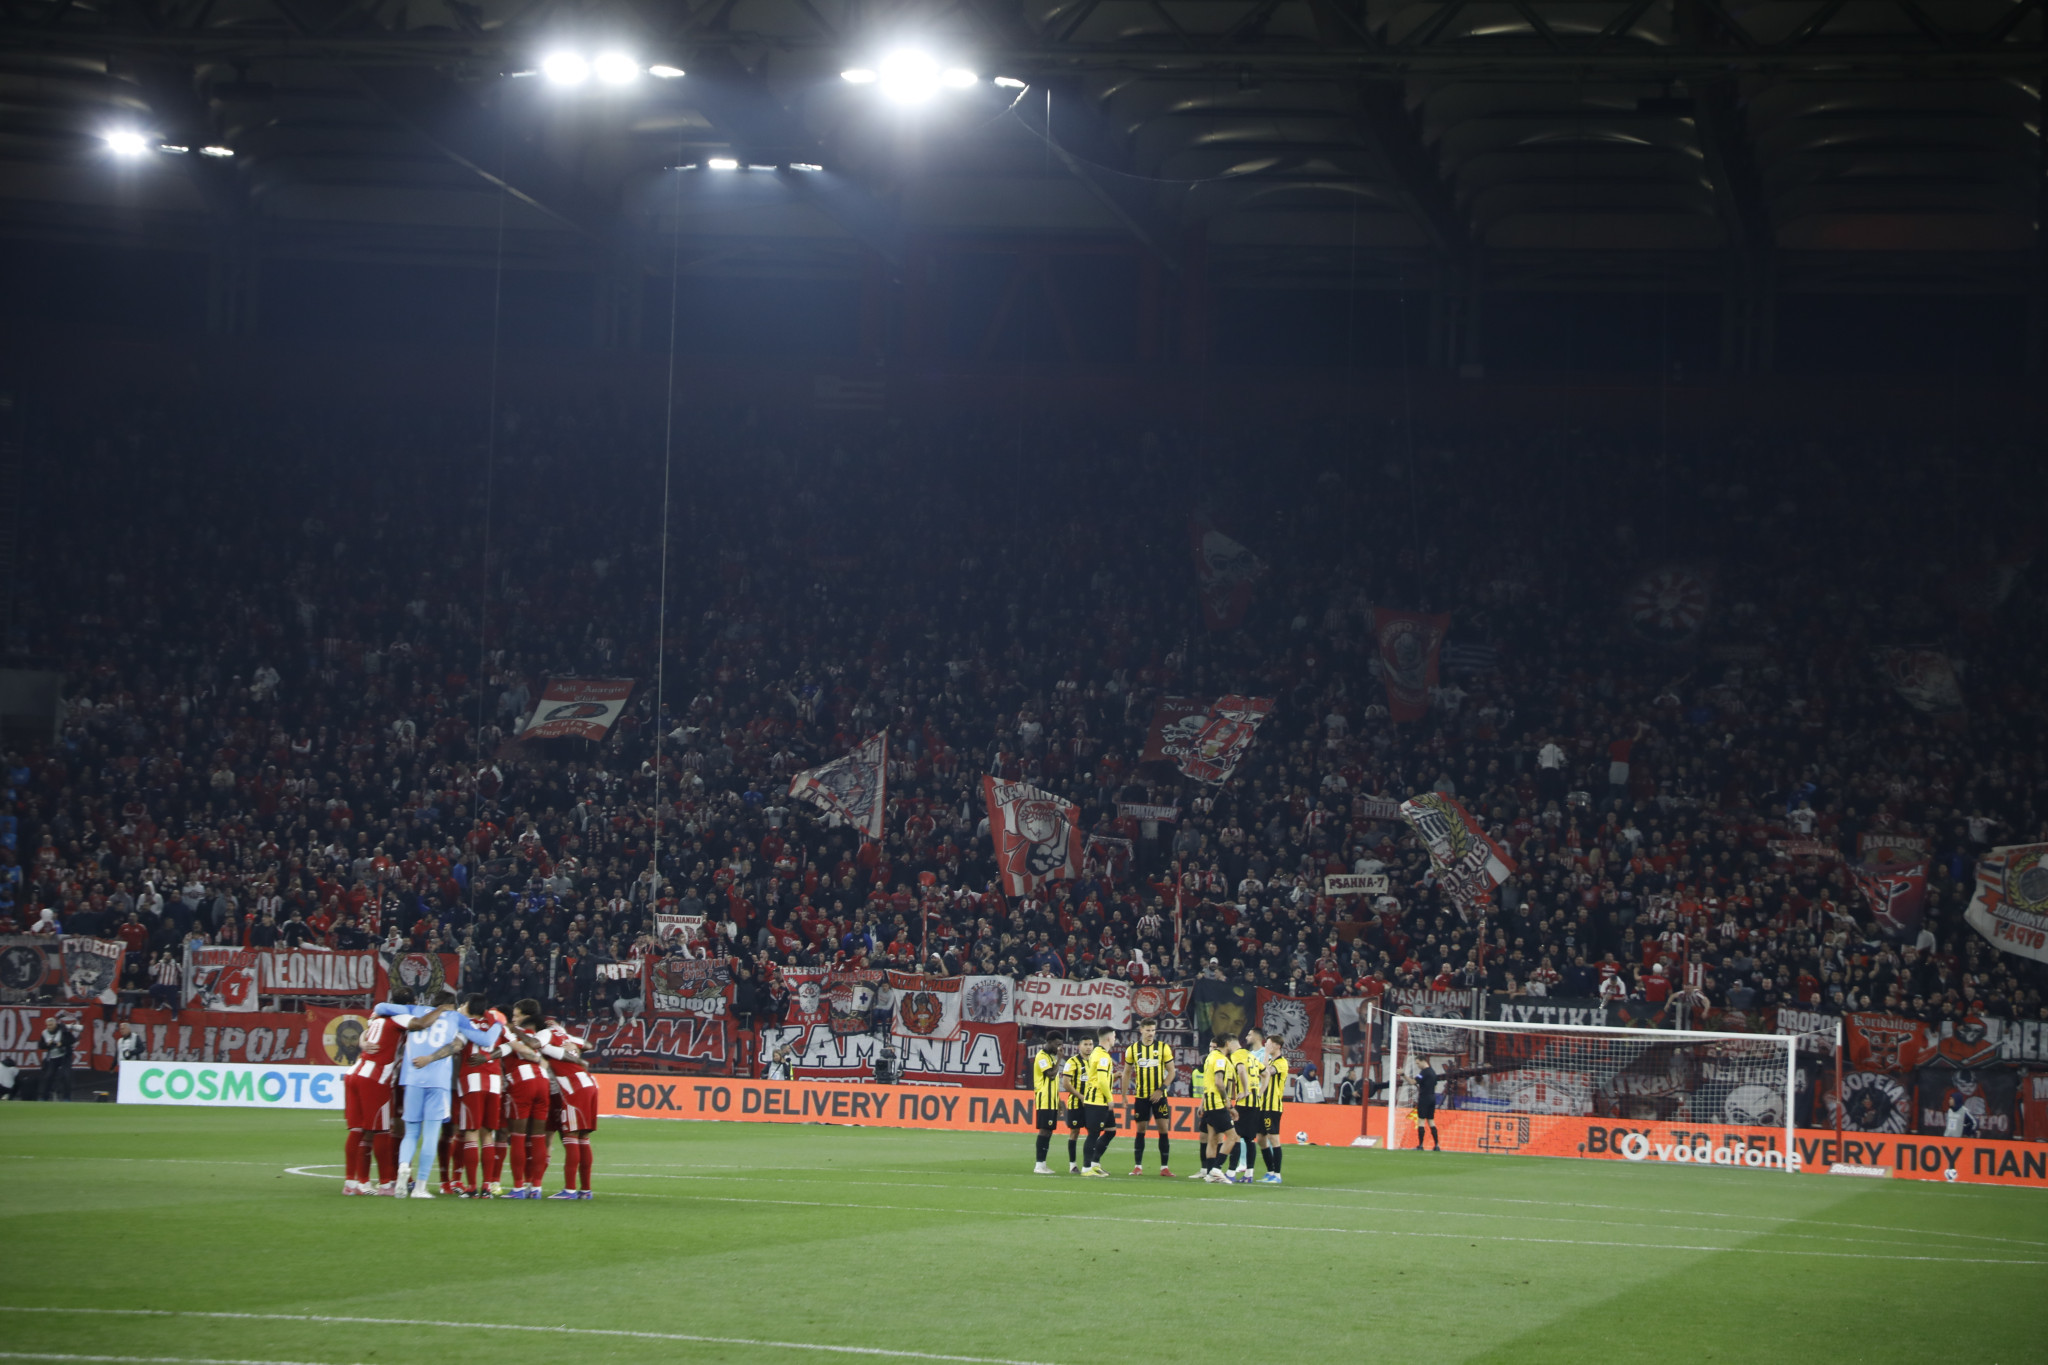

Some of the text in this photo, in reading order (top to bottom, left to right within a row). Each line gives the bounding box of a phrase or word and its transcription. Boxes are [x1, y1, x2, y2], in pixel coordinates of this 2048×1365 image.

[992, 782, 1073, 809] KAMINIA
[1364, 801, 1401, 818] ΕΡΕΤΡΙ
[1863, 836, 1927, 852] ΑΝΔΡΟΣ
[61, 938, 120, 960] ΓΥΘΕΙΟ
[259, 951, 374, 990] ΛΕΩΝΙΔΙΟ
[230, 983, 240, 997] 7
[1015, 980, 1051, 994] RED
[1391, 988, 1472, 1007] PASALIMANI
[1014, 1000, 1027, 1017] K.
[1031, 1001, 1112, 1021] PATISSIA
[0, 1008, 40, 1050] ΟΣ
[139, 1067, 335, 1105] COSMOTE
[1744, 1066, 1807, 1090] LIOSA
[2034, 1077, 2048, 1100] M
[616, 1082, 683, 1112] BOX.
[693, 1085, 731, 1113] TO
[741, 1087, 891, 1119] DELIVERY
[899, 1094, 960, 1122] ΠΟΥ
[1924, 1108, 2009, 1132] ΚΑΕΡΟ
[1655, 1140, 1803, 1169] vodafone
[1896, 1143, 1963, 1173] ΠΟΥ
